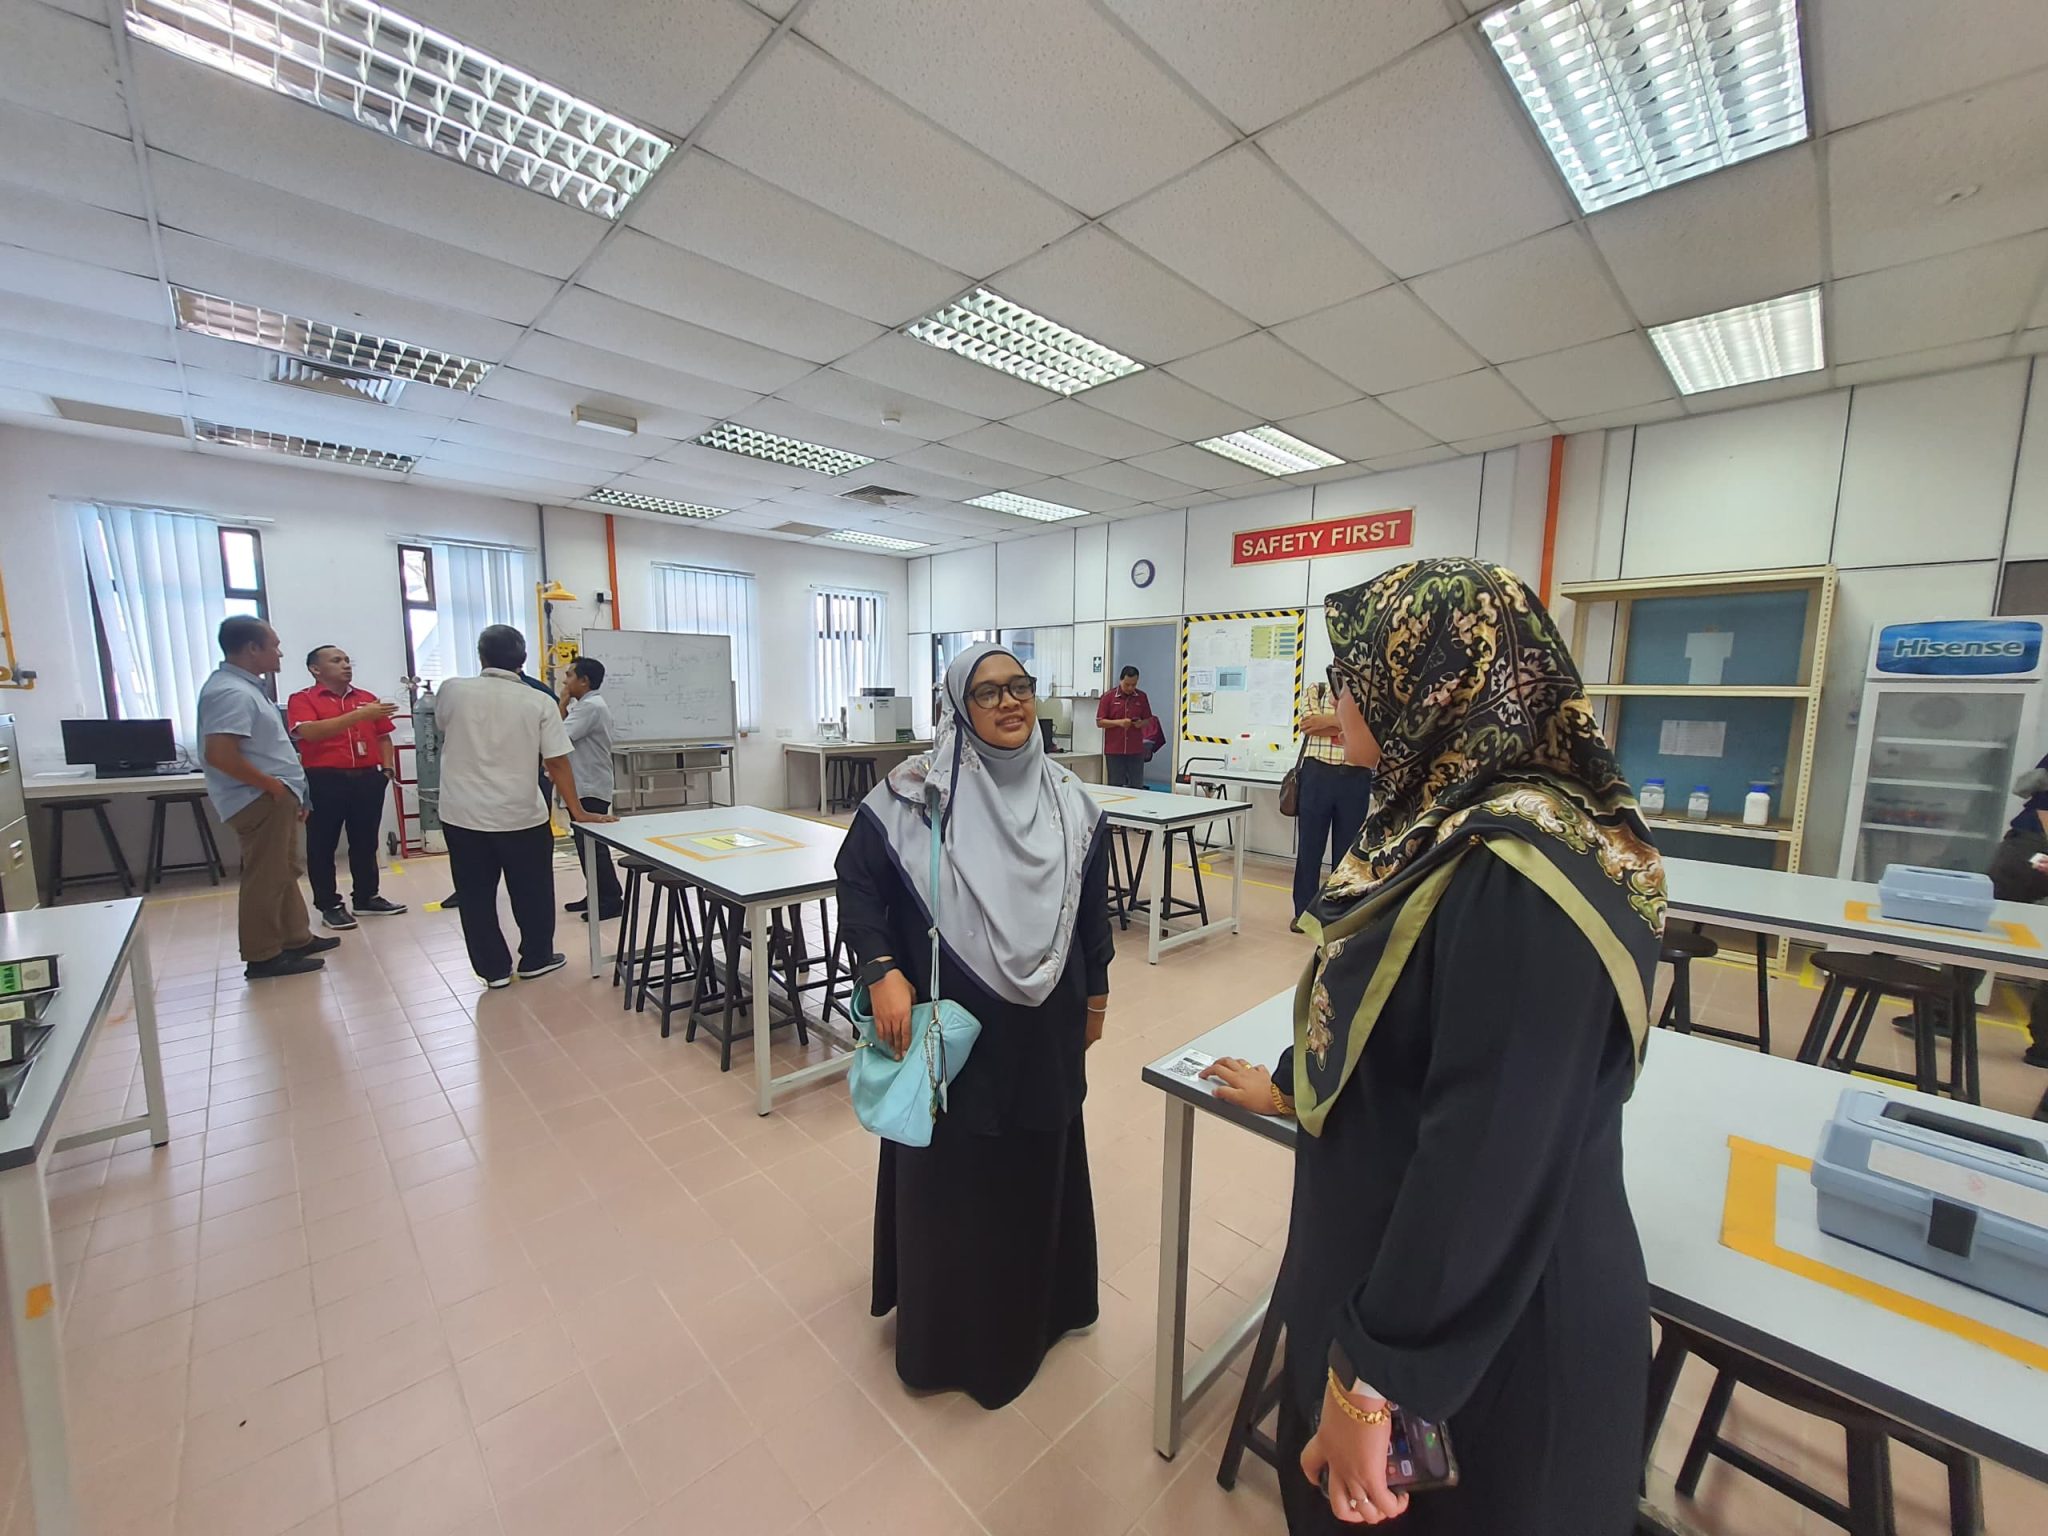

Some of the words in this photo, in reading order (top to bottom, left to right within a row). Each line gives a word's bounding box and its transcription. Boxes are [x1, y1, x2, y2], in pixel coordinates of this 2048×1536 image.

[1242, 530, 1323, 557] SAFETY
[1331, 519, 1401, 546] FIRST
[1895, 638, 2023, 657] Hisense
